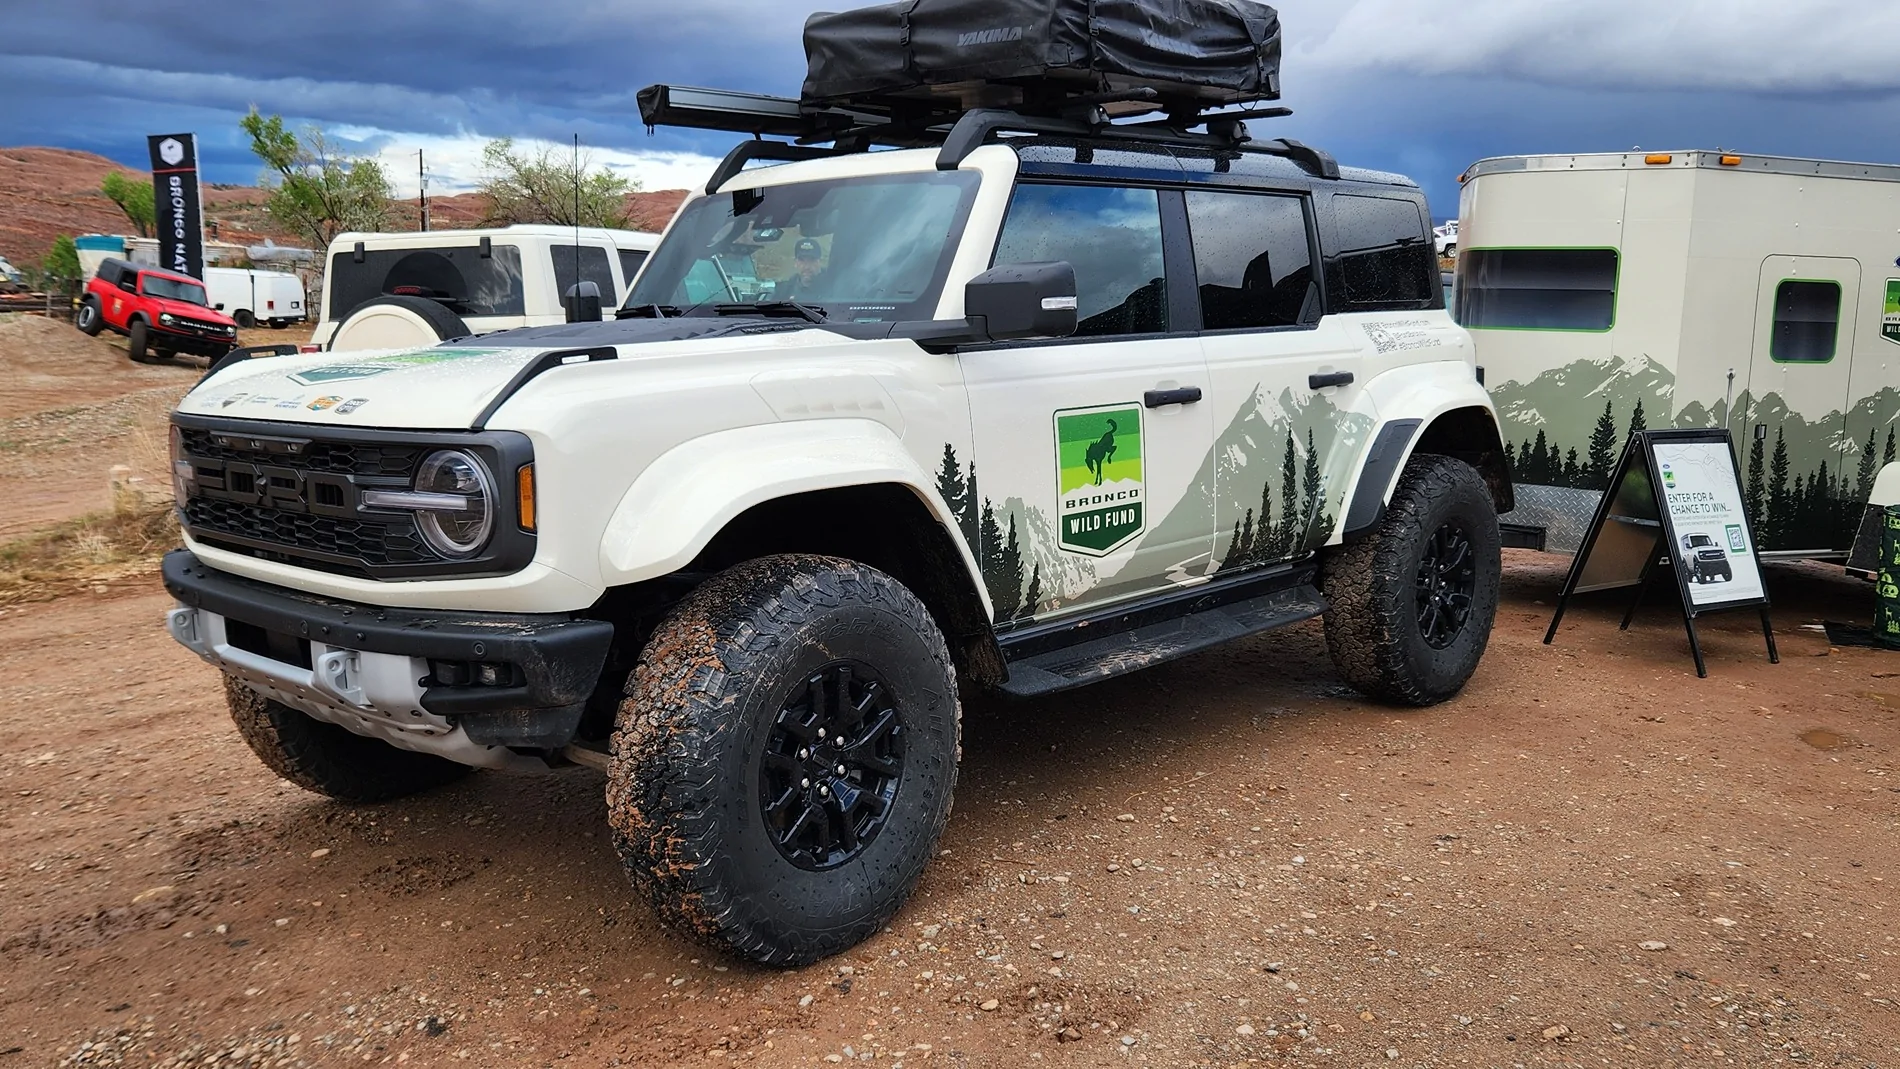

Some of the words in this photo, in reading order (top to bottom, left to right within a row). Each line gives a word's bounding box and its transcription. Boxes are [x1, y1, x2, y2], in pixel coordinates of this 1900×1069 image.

[957, 27, 1022, 46] YAKIMA
[169, 176, 186, 239] BRONCO
[1066, 489, 1139, 509] BRONCO
[1668, 493, 1692, 503] ENTER
[1693, 492, 1707, 502] FOR
[1708, 492, 1714, 501] A
[1671, 504, 1699, 514] CHANCE
[1701, 503, 1710, 513] TO
[1071, 515, 1100, 534] WILD
[1105, 509, 1135, 528] FUND
